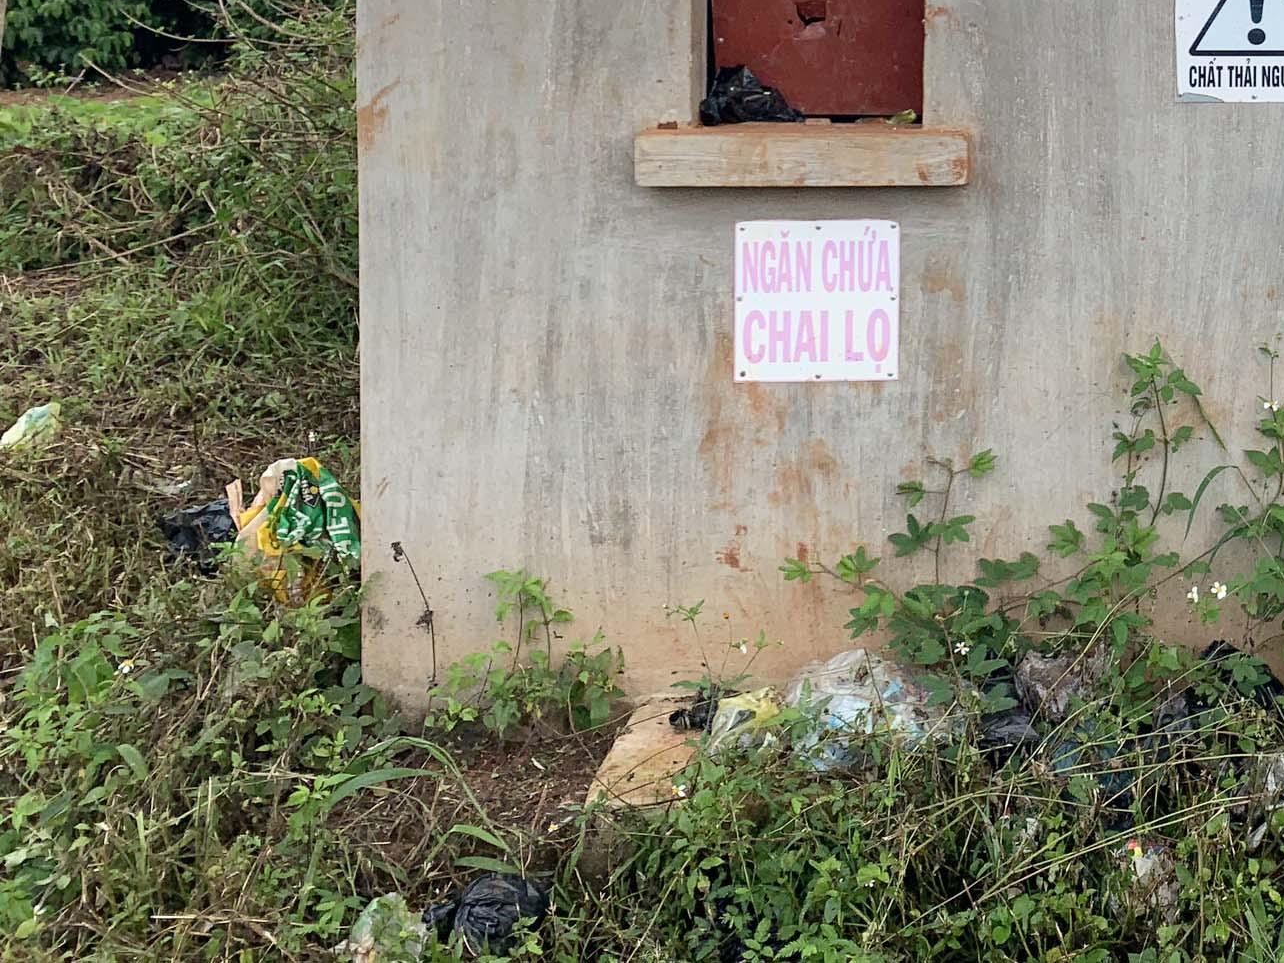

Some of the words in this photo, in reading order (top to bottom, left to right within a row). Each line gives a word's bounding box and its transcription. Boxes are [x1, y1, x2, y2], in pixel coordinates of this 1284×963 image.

[1189, 57, 1223, 88] CHẤT
[1227, 58, 1257, 88] THẢI
[742, 230, 812, 293] NGĂN
[822, 225, 891, 293] CHỨA
[742, 309, 829, 365] CHAI
[844, 308, 891, 373] LỌ
